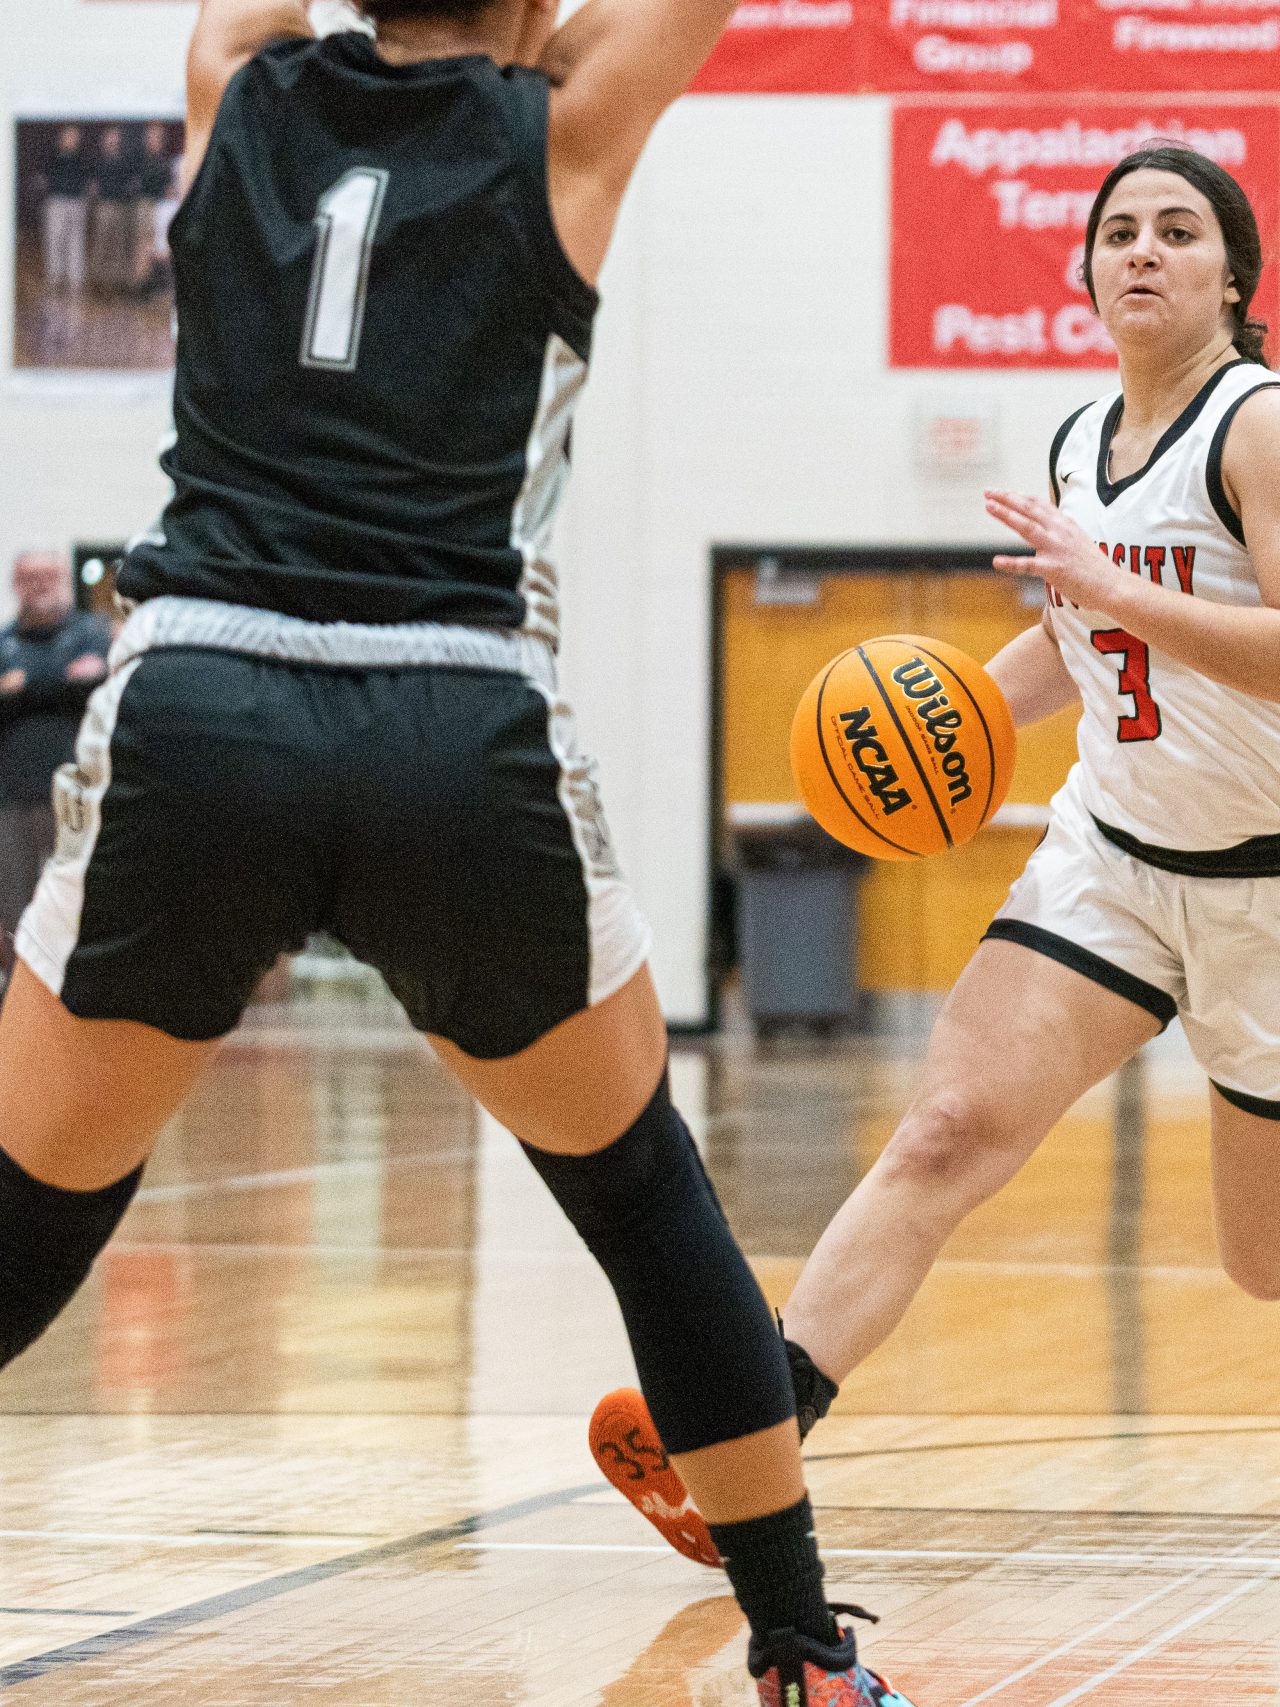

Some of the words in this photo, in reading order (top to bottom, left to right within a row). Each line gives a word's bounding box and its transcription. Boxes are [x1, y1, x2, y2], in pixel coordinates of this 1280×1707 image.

[914, 35, 1033, 73] Group
[299, 166, 389, 372] 1
[932, 304, 1046, 354] Pest
[891, 656, 973, 808] Wilson
[1090, 627, 1162, 743] 3
[839, 706, 913, 816] NCAA
